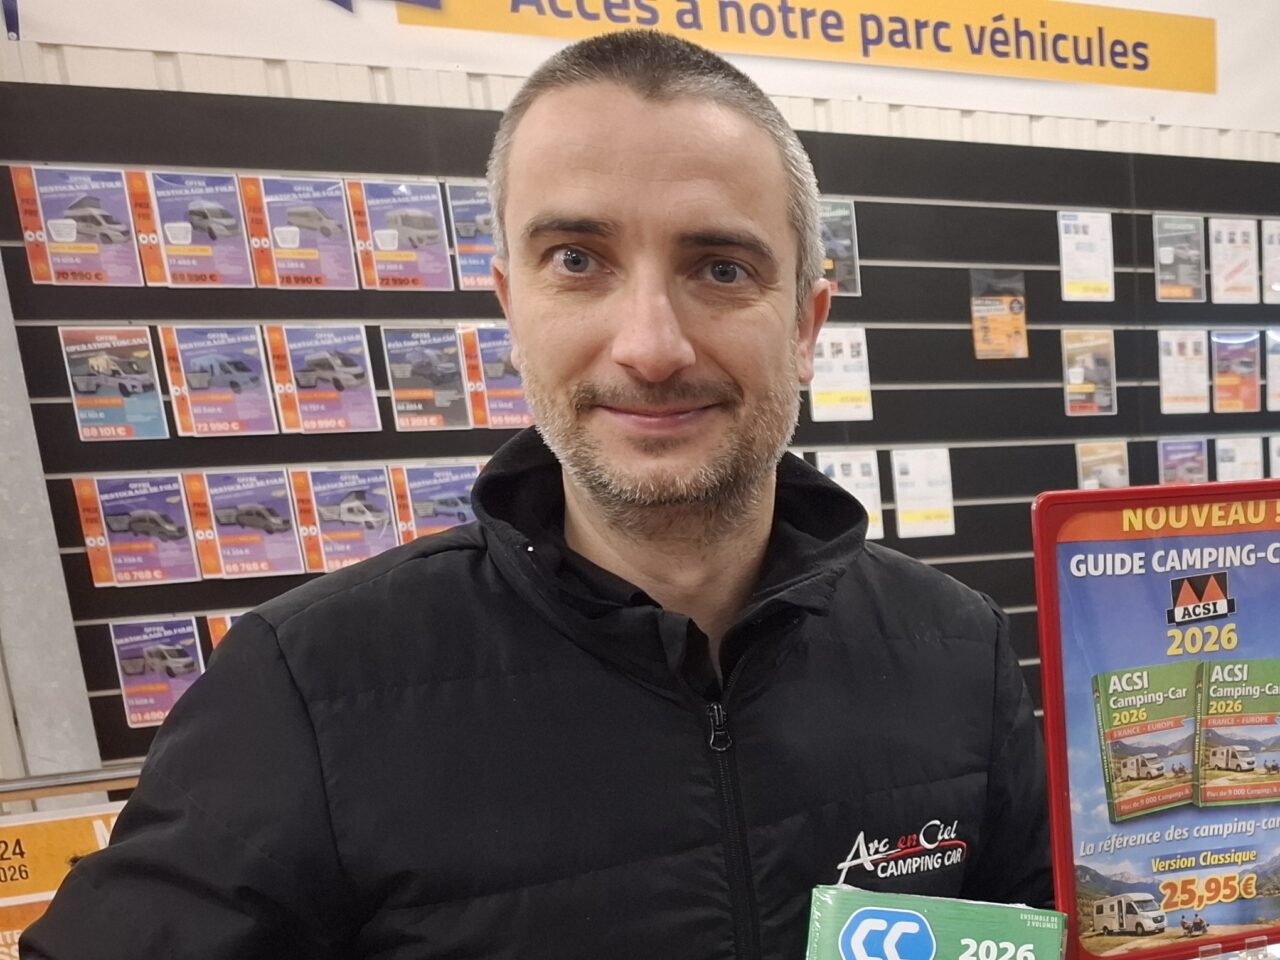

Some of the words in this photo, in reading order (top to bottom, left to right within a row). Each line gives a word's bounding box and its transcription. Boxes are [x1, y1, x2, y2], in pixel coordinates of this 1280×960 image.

[720, 0, 844, 42] notre
[860, 13, 952, 57] parc
[965, 14, 1149, 71] véhicules
[1121, 500, 1267, 532] NOUVEAU
[1070, 552, 1146, 577] GUIDE
[1181, 602, 1219, 620] ACSI
[1166, 623, 1239, 656] 2026
[1108, 671, 1148, 693] ACSI
[1211, 664, 1248, 682] ACSI
[1109, 686, 1188, 709] Camping-Car
[1208, 699, 1242, 714] 2026
[1112, 708, 1147, 726] 2026
[1208, 716, 1236, 726] FRANCE
[1241, 714, 1269, 724] EUROPE
[1113, 726, 1141, 739] FRANCE
[1147, 720, 1174, 732] EUROPE
[837, 831, 889, 885] Arc
[896, 834, 917, 849] en
[919, 819, 959, 849] Ciel
[1079, 841, 1095, 858] La
[1098, 827, 1160, 854] référence
[1165, 823, 1189, 841] des
[877, 854, 942, 878] CAMPING
[944, 848, 963, 866] CAR
[1151, 854, 1196, 873] Version
[1199, 849, 1257, 867] Classique
